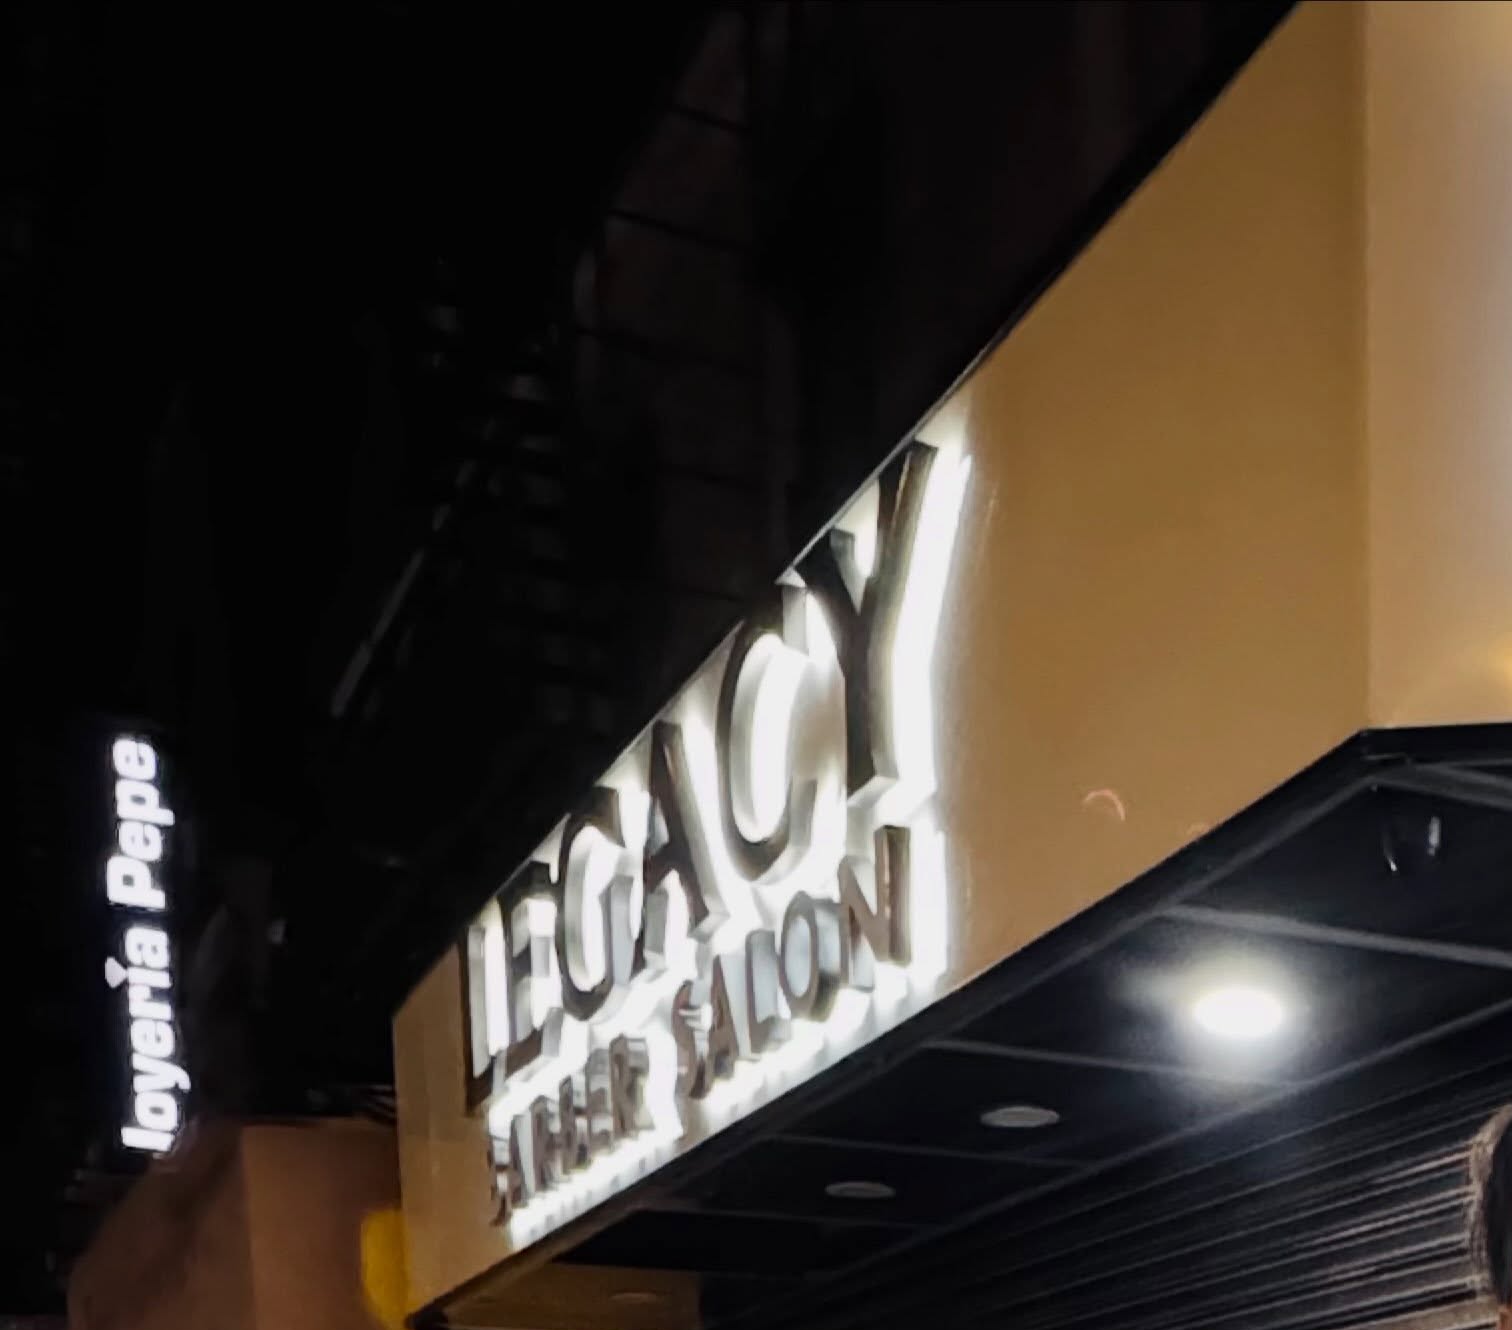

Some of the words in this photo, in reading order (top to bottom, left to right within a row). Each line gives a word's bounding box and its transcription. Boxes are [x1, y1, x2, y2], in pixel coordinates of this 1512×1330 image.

[106, 737, 175, 910] Pepe
[462, 440, 945, 1117] LEGACY
[671, 824, 912, 1100] SALON
